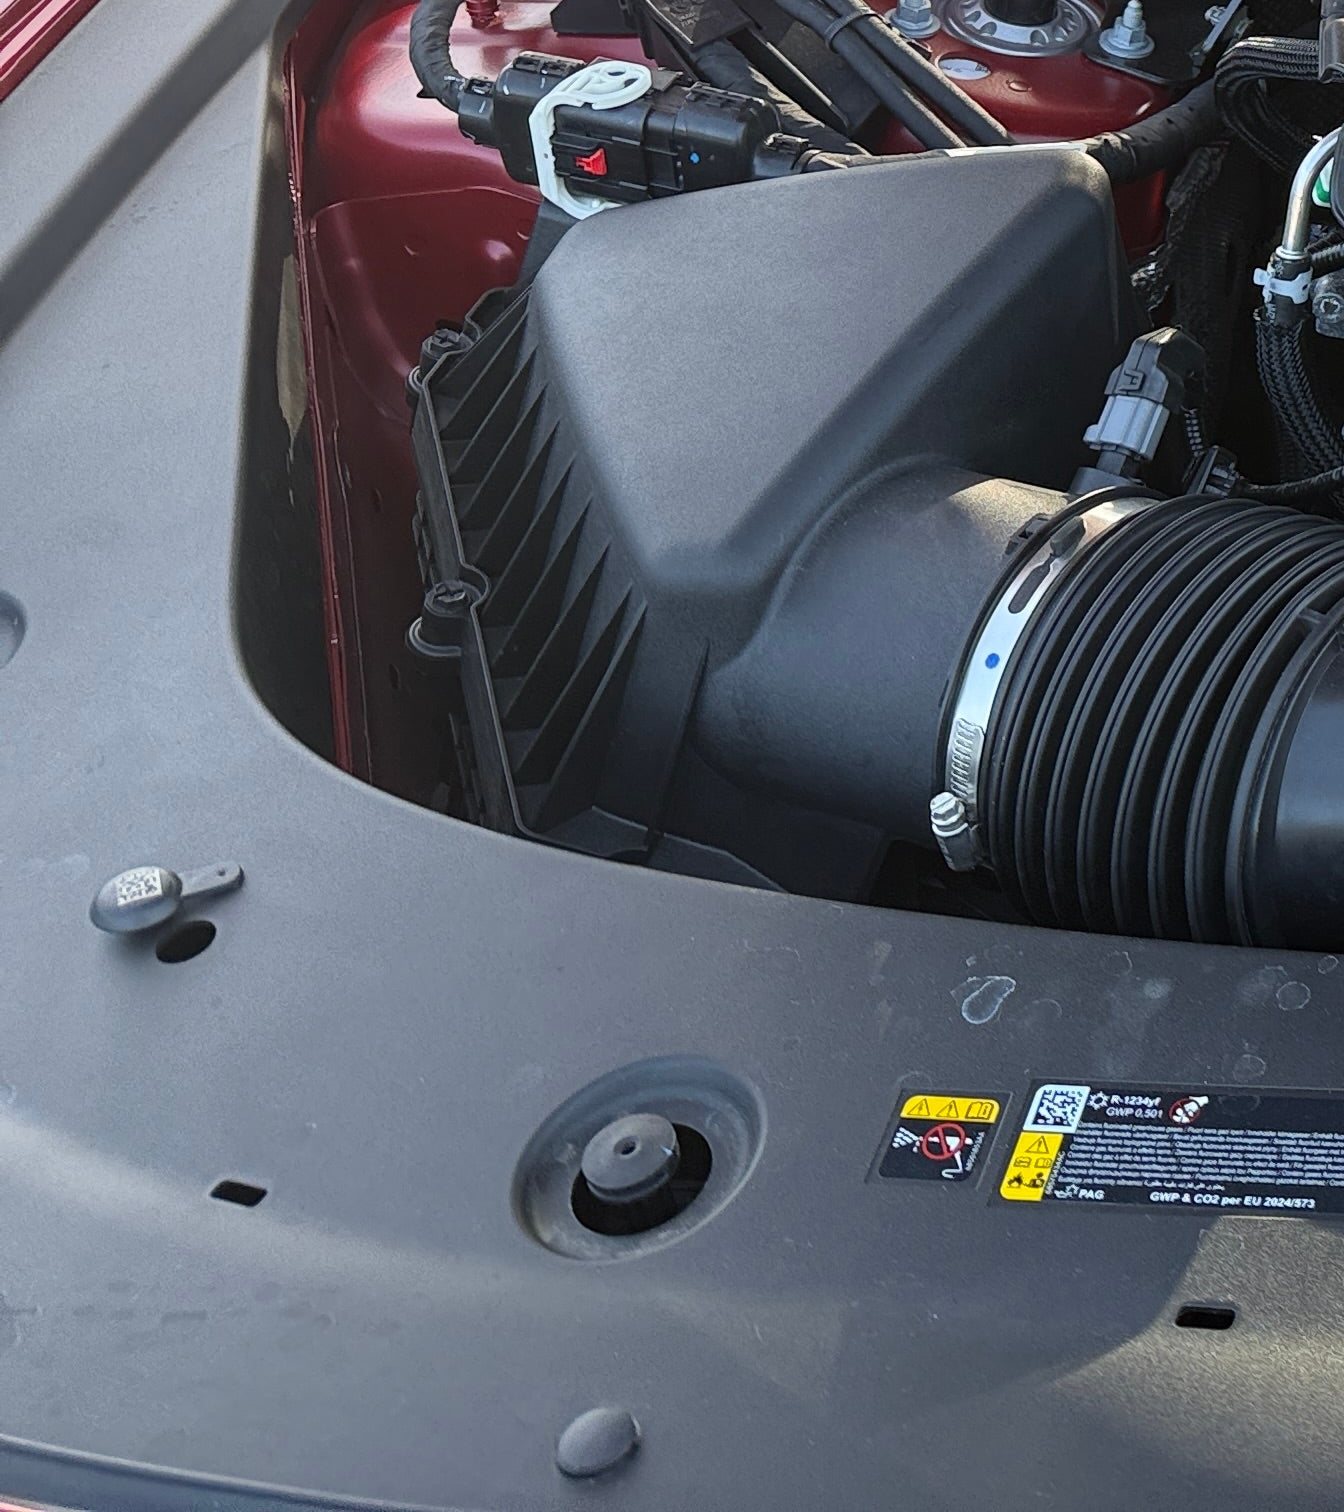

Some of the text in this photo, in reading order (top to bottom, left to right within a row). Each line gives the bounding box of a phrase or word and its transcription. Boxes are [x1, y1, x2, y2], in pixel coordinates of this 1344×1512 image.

[1110, 1094, 1161, 1108] R-1234yf
[1105, 1106, 1134, 1117] GWP
[1078, 1188, 1105, 1201] PAG
[1149, 1190, 1181, 1203] GWP
[1181, 1192, 1192, 1204] &
[1193, 1193, 1220, 1205] CO2
[1220, 1196, 1243, 1207] per
[1243, 1195, 1262, 1207] EU
